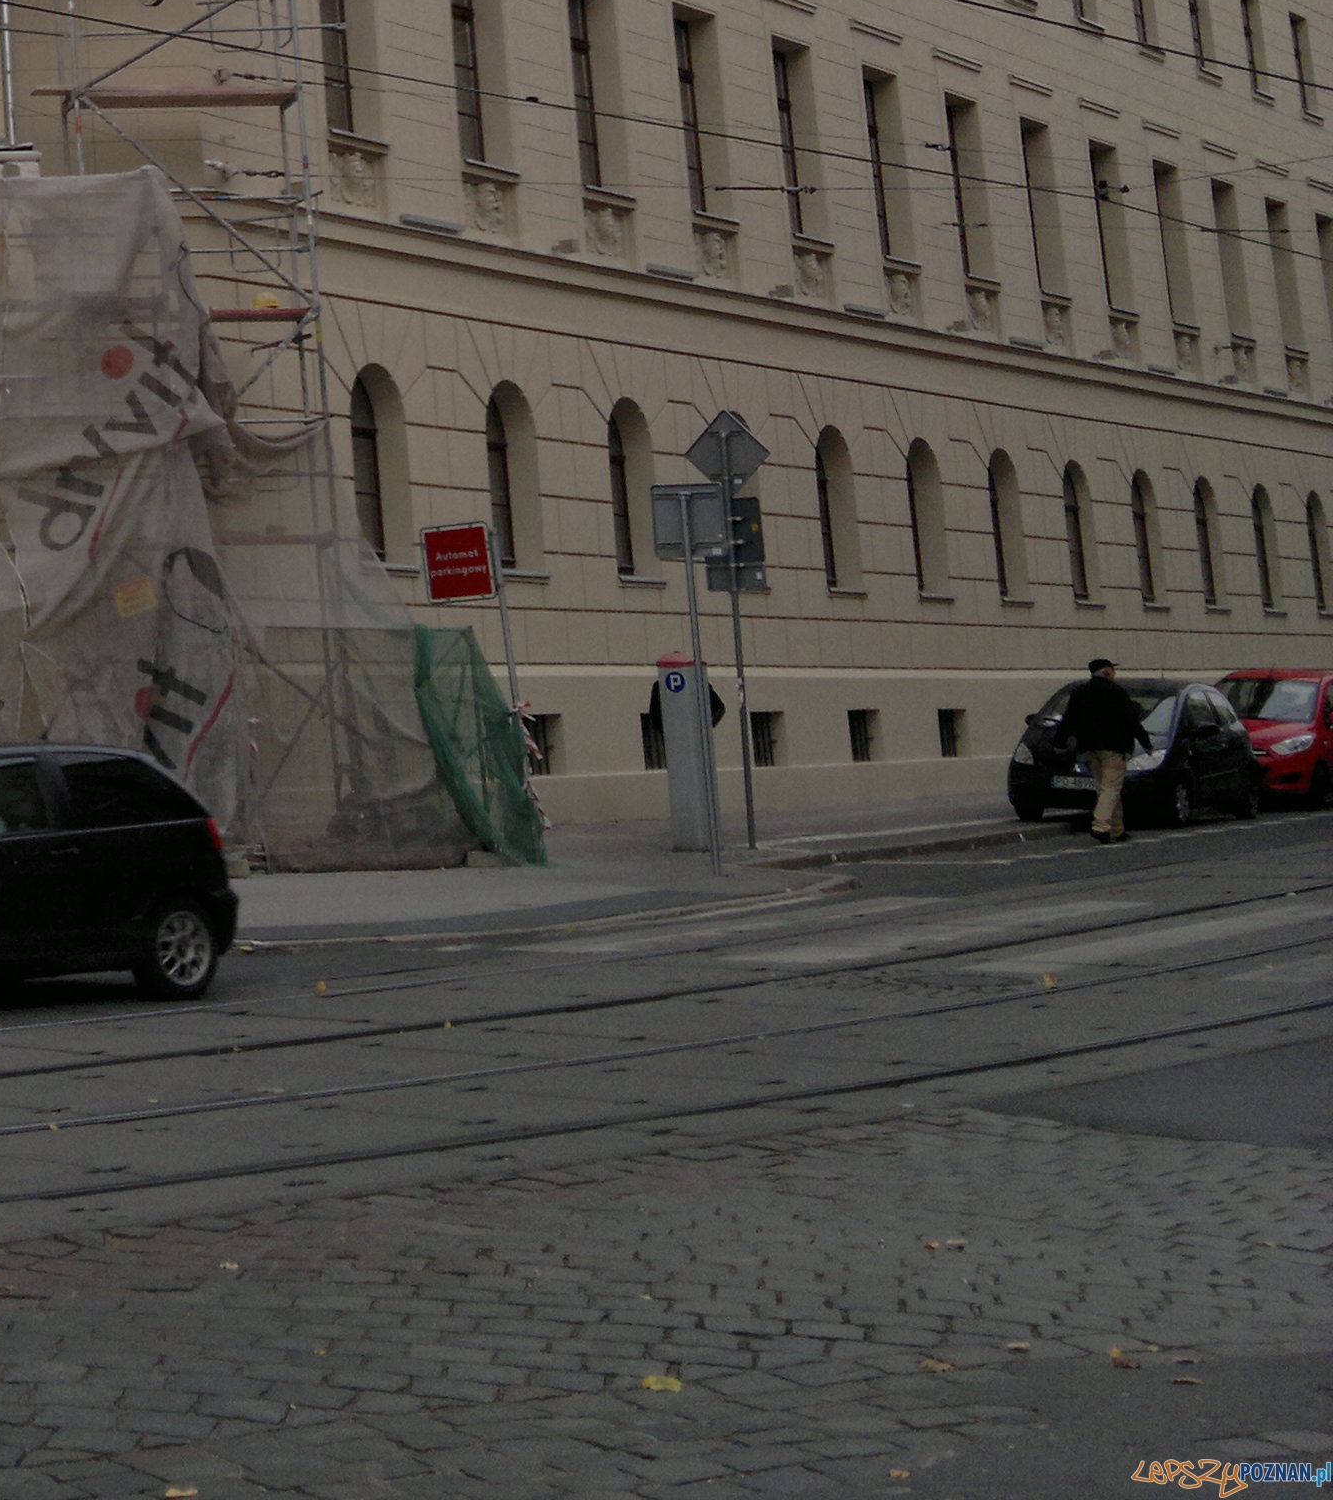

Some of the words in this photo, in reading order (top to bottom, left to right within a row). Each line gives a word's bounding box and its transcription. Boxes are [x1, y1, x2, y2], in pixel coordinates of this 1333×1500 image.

[436, 549, 479, 561] Automat
[431, 565, 487, 579] parkingowy
[669, 674, 682, 690] P
